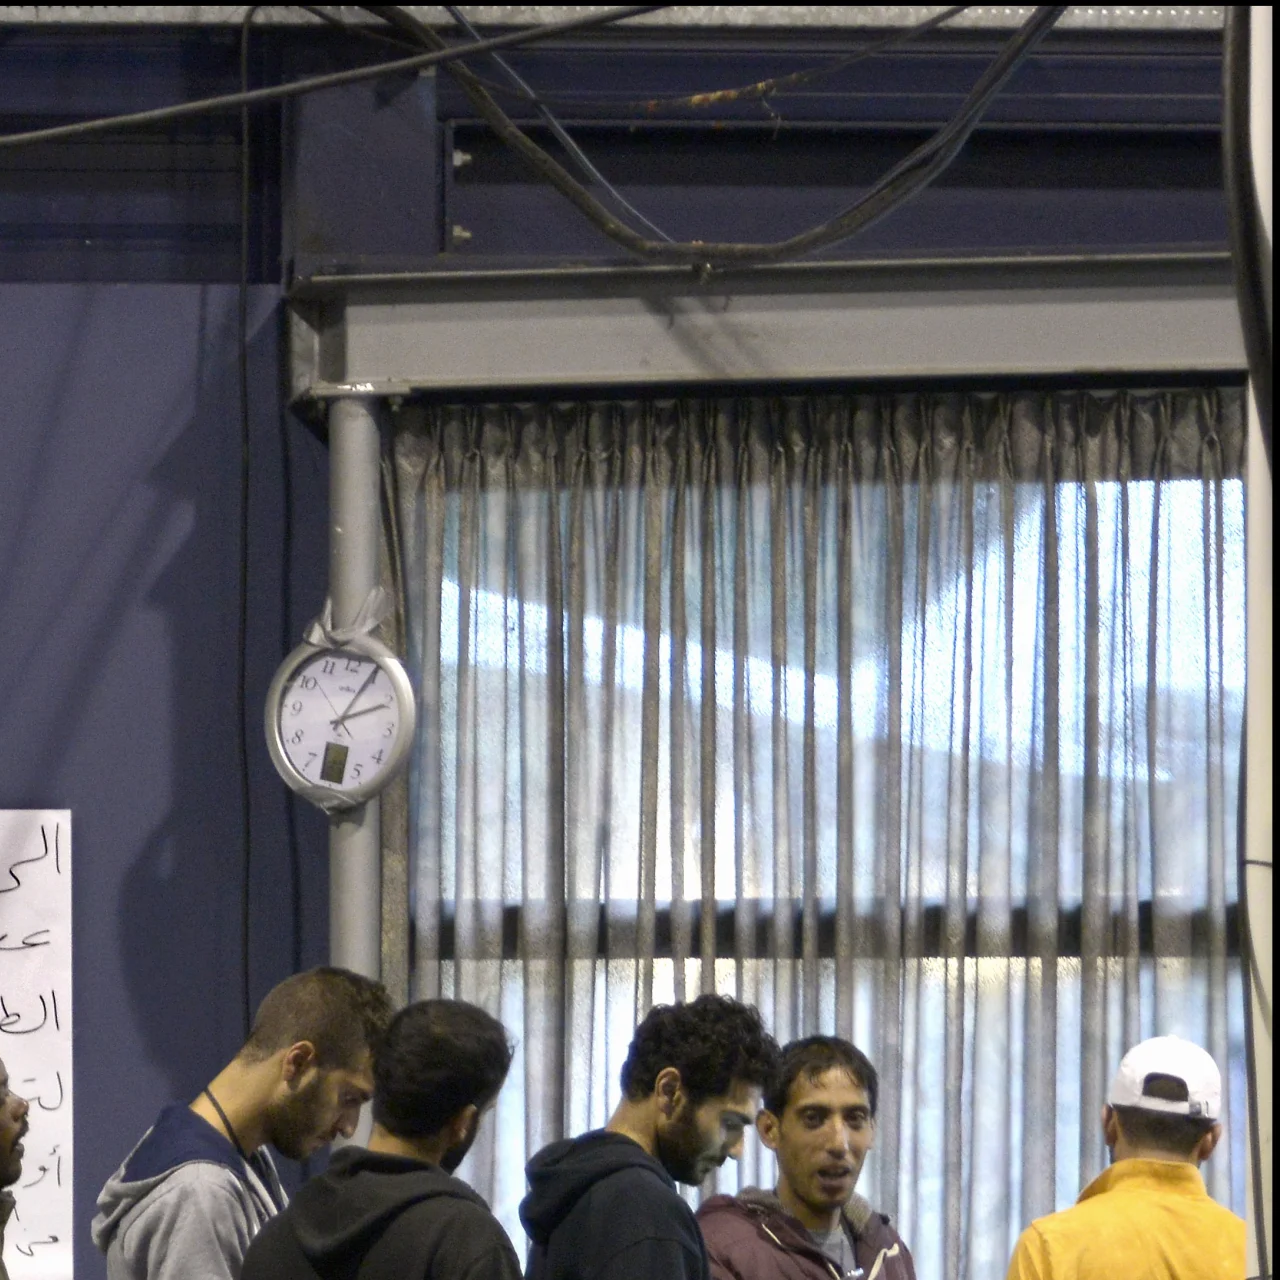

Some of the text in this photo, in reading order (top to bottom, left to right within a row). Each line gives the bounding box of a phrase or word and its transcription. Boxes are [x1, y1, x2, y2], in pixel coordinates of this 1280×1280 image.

[322, 660, 336, 675] 11
[345, 658, 362, 674] 12
[299, 675, 317, 691] 10
[292, 701, 302, 715] 9
[291, 730, 304, 744] 8
[305, 752, 317, 768] 7
[371, 748, 384, 765] 4
[351, 764, 364, 778] 5
